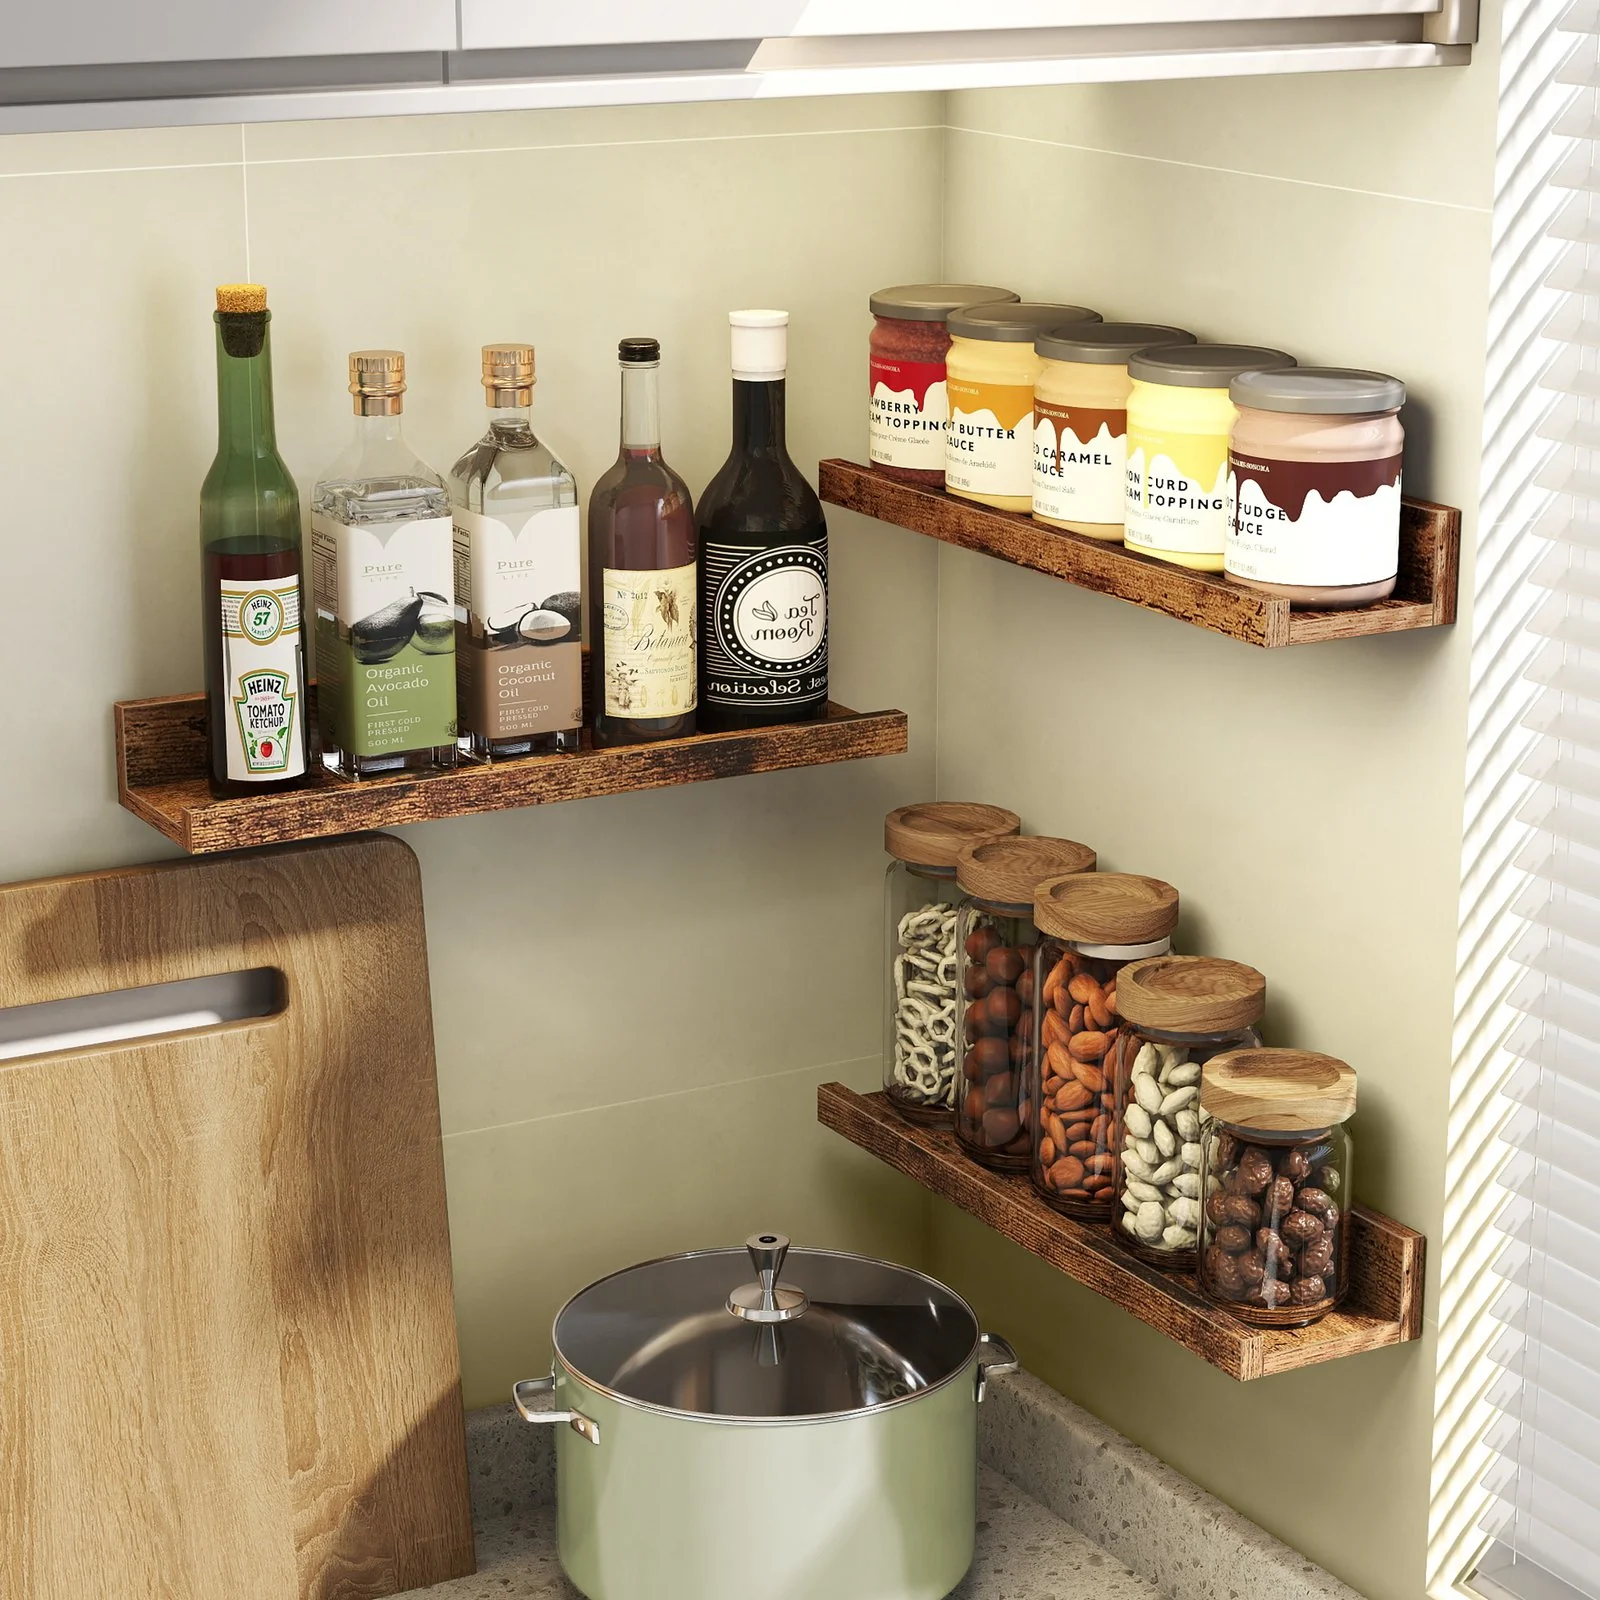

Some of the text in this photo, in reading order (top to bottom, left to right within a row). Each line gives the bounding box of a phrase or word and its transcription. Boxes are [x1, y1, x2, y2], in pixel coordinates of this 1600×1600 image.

[959, 423, 1015, 440] BUTTER
[946, 434, 975, 452] SAUCE
[1043, 447, 1112, 465] CARAMEL
[1033, 459, 1064, 478] SAUCE
[1148, 493, 1222, 510] TOPPING
[1238, 502, 1286, 521] FUDGE
[1228, 515, 1263, 535] SAUCE
[364, 563, 402, 574] Pure
[497, 559, 533, 570] Pure
[250, 599, 273, 611] HEINZ
[253, 611, 271, 627] 57
[366, 662, 424, 680] Organic
[498, 659, 553, 676] Organic
[247, 678, 282, 696] HEINZ
[366, 677, 429, 694] Avocado
[498, 671, 556, 687] Coconut
[498, 687, 519, 699] Oil
[246, 702, 285, 718] TOMATO
[366, 695, 389, 709] Oil
[499, 704, 549, 717] FIRST COLD
[499, 712, 539, 722] PRESSED
[249, 716, 285, 729] KETCHUP
[367, 716, 421, 729] FIRST COLD
[499, 724, 518, 732] 500
[367, 725, 410, 737] PRESSED
[367, 738, 388, 748] 500
